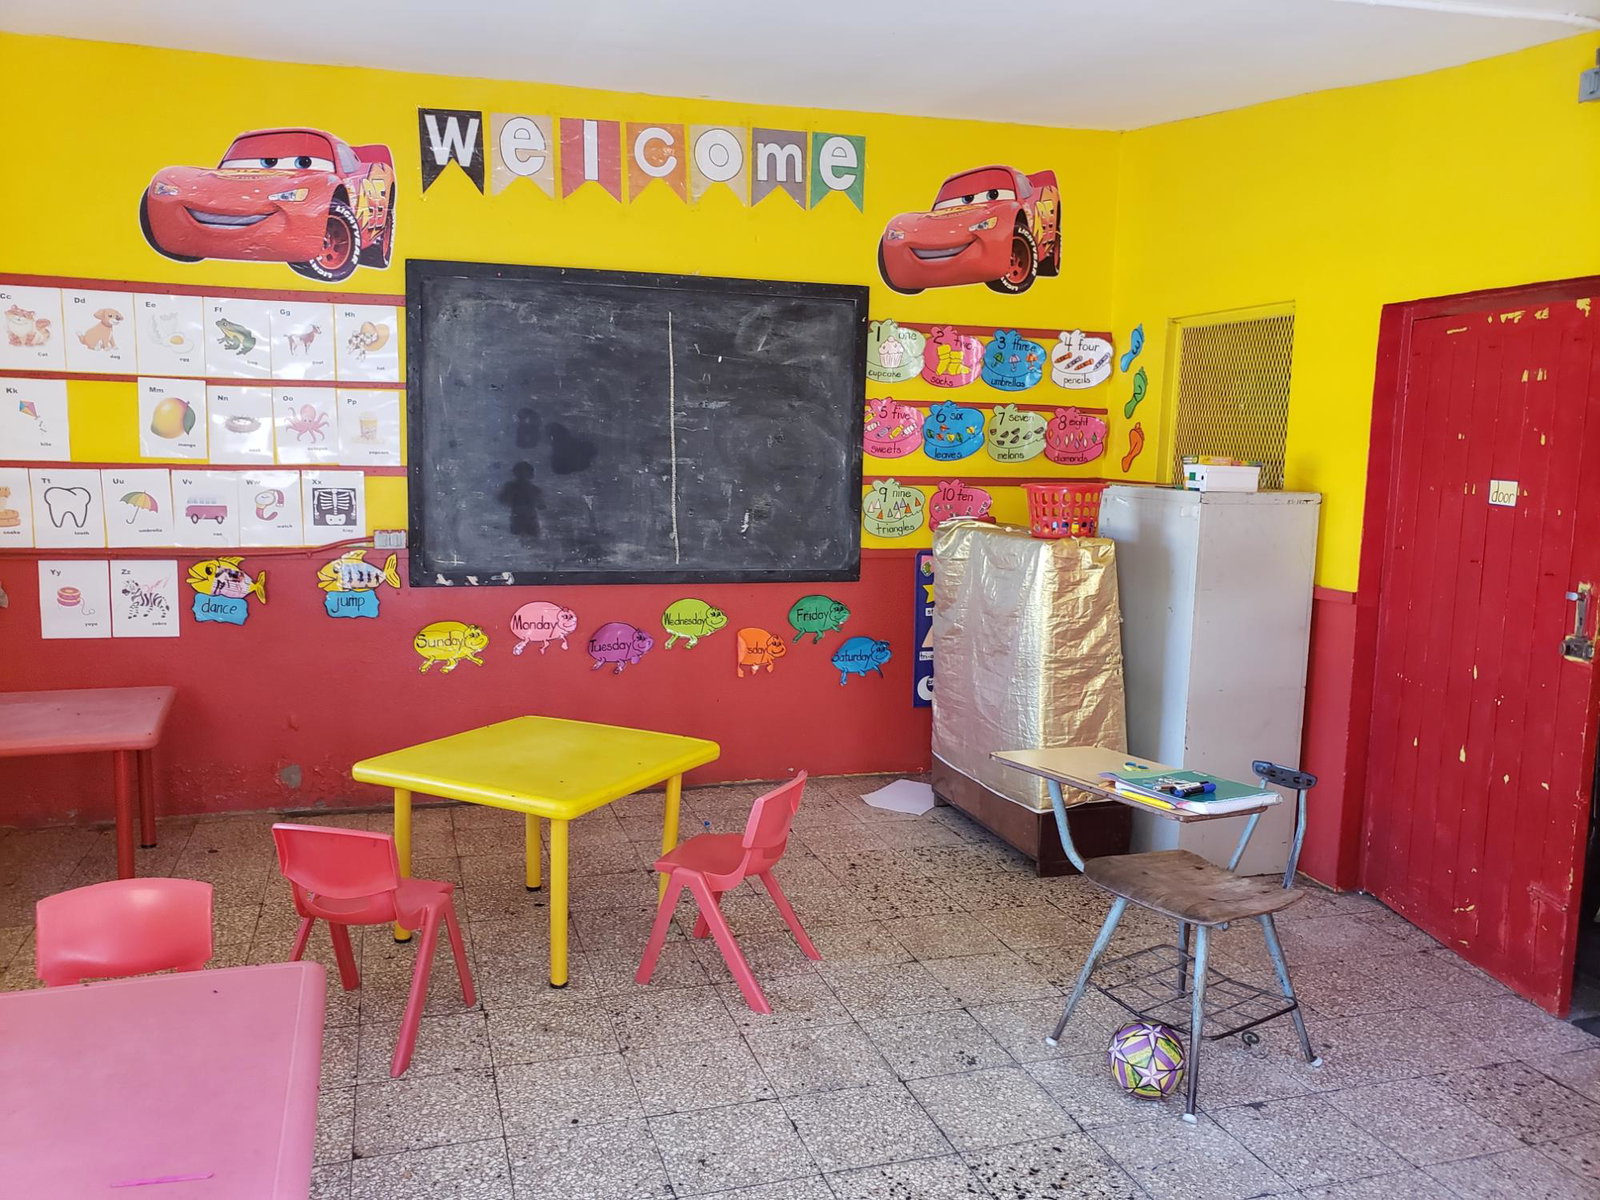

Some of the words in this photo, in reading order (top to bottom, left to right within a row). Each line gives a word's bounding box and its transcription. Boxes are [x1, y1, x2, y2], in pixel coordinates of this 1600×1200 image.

[335, 205, 361, 265] LIGHTYEAR
[1017, 227, 1038, 277] LIGHTYEAR
[280, 308, 291, 316] Gg
[876, 326, 880, 342] 1
[898, 331, 917, 340] one
[933, 331, 945, 345] 2
[997, 336, 1007, 350] 3
[1012, 338, 1037, 352] three
[1064, 337, 1073, 351] 4
[1078, 339, 1100, 352] four
[1131, 340, 1141, 355] 3
[868, 369, 902, 379] cupcake
[931, 376, 954, 387] socks
[1063, 373, 1091, 388] pencils
[990, 376, 1026, 388] umbrellas
[1133, 385, 1143, 402] 2
[347, 398, 357, 406] Pp
[879, 406, 888, 419] 5
[892, 404, 910, 420] five
[936, 408, 946, 423] 6
[950, 410, 964, 420] six
[998, 412, 1006, 425] 7
[1058, 415, 1067, 430] 8
[1069, 419, 1089, 430] eight
[870, 442, 902, 454] sweets
[934, 448, 963, 459] leaves
[997, 447, 1025, 460] melons
[878, 487, 888, 502] 9
[892, 489, 911, 498] nine
[942, 488, 955, 501] 10
[957, 489, 973, 501] ten
[1491, 481, 1515, 503] door
[875, 522, 915, 536] triangles
[201, 598, 237, 614] dance
[330, 595, 366, 613] jump
[663, 612, 706, 634] Wednesday
[796, 607, 829, 628] Friday
[512, 614, 559, 638] Monday
[416, 631, 464, 654] Sunday
[589, 635, 632, 658] Tuesday
